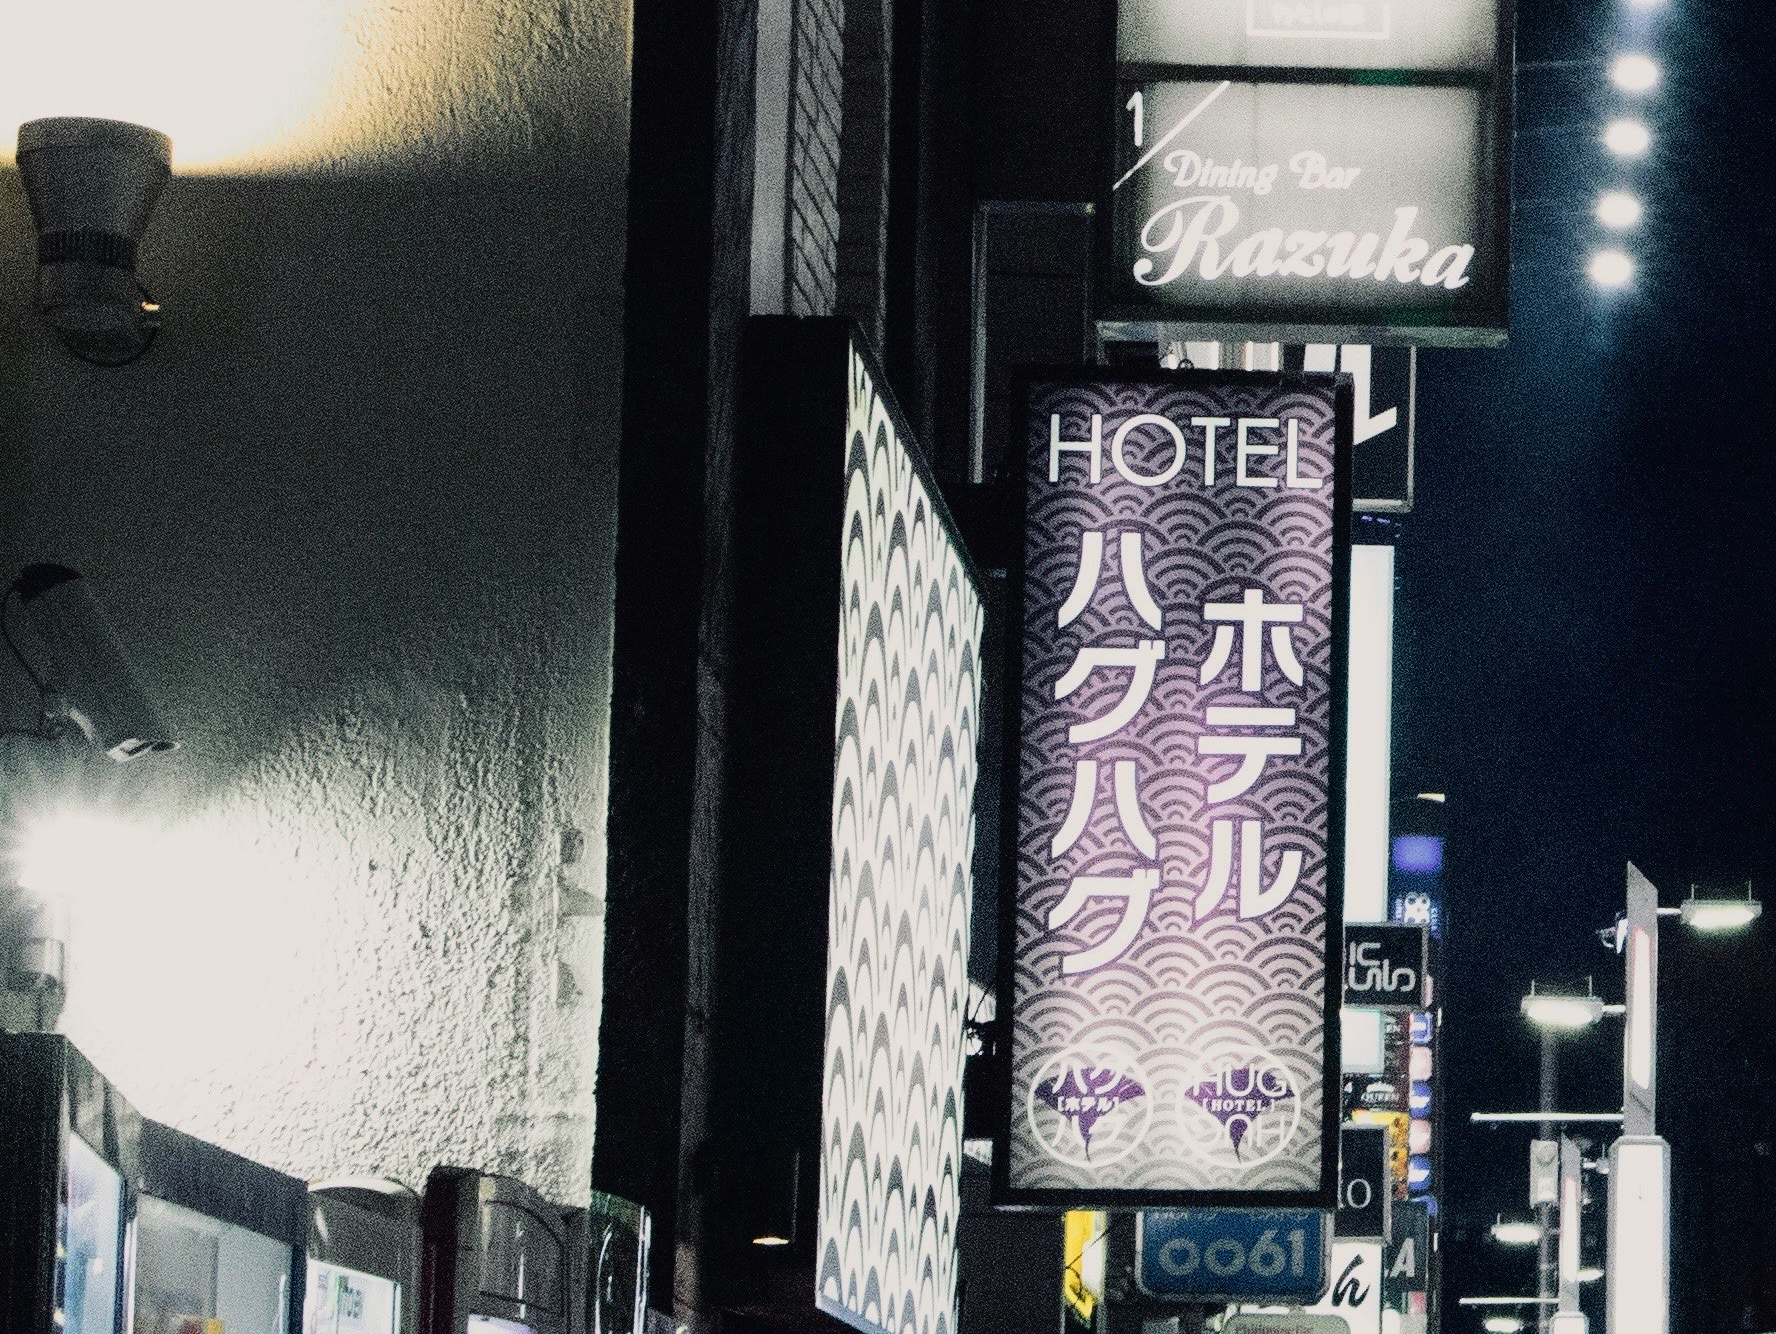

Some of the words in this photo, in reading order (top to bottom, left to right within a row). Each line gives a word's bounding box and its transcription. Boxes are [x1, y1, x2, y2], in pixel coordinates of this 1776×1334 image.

[1125, 91, 1143, 146] 1
[1164, 150, 1279, 194] Dining
[1289, 150, 1361, 190] Bar
[1133, 196, 1475, 291] Razuka
[1048, 414, 1323, 489] HOTEL
[1049, 531, 1165, 975] ハグハグ
[1198, 589, 1304, 922] ホテル
[1191, 1063, 1288, 1097] HUG
